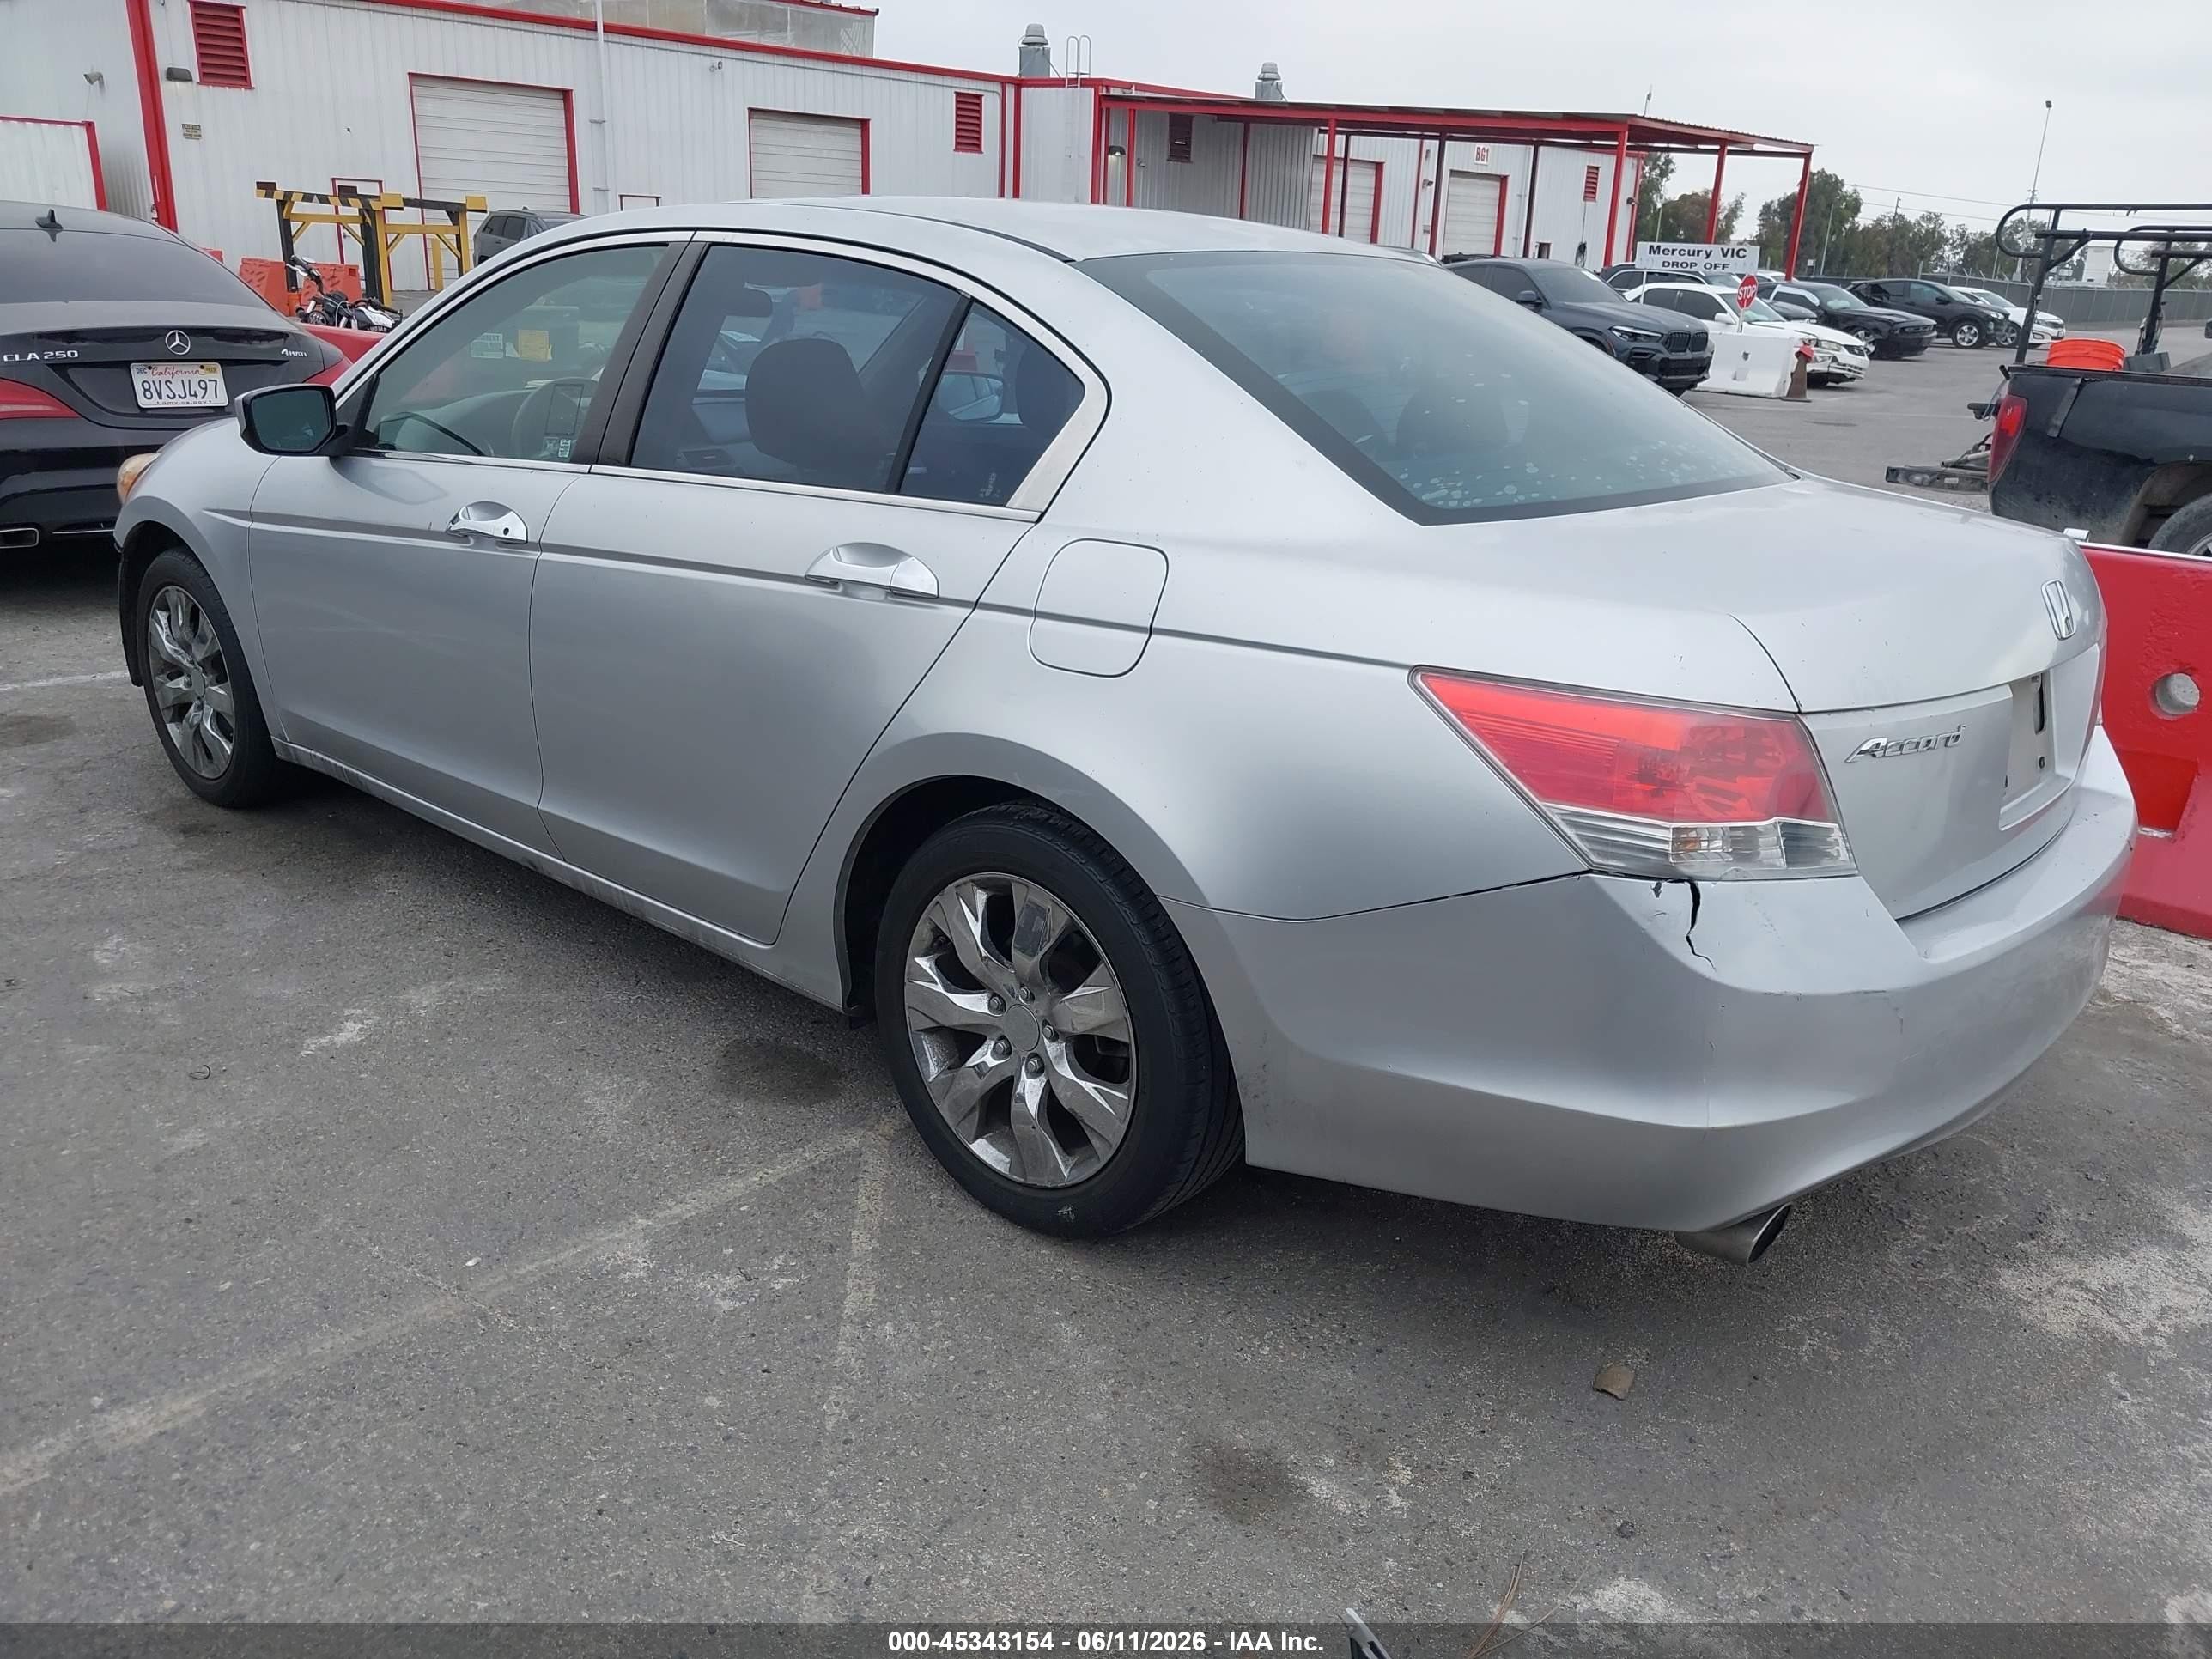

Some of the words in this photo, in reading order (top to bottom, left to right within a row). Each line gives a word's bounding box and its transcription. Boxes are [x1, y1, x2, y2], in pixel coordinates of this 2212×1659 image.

[1649, 245, 1713, 259] Mercury
[1721, 247, 1747, 258] VIC
[1662, 260, 1698, 269] DROP
[1703, 262, 1730, 270] OFF
[1737, 284, 1757, 301] STOP
[3, 352, 40, 362] CLA
[43, 350, 79, 360] 250
[151, 365, 204, 379] California
[141, 379, 218, 400] 8VSJ497
[1844, 724, 1966, 763] Accord
